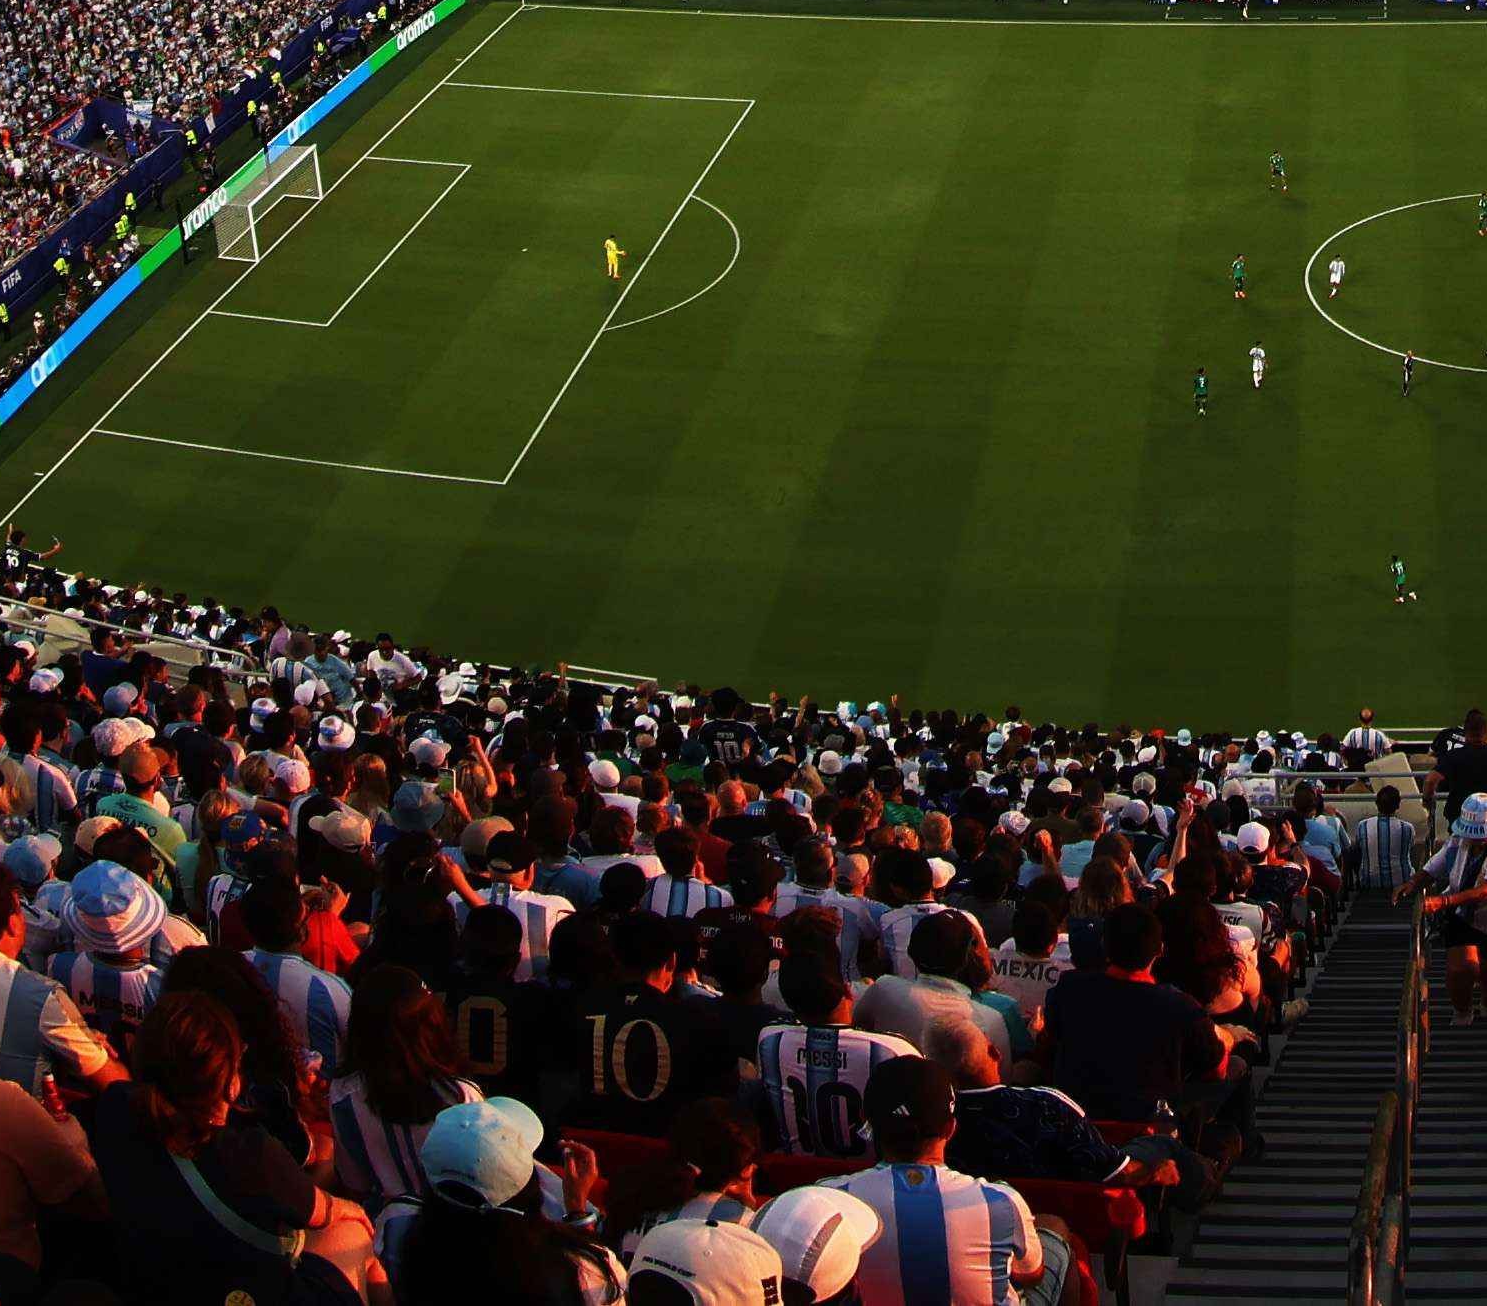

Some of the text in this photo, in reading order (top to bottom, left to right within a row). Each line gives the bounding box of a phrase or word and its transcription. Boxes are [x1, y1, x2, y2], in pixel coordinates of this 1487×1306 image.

[396, 10, 436, 51] aramco
[1, 268, 22, 294] FIFA
[584, 1012, 673, 1102] 10
[796, 1047, 848, 1070] MESSI
[778, 1075, 868, 1157] 10
